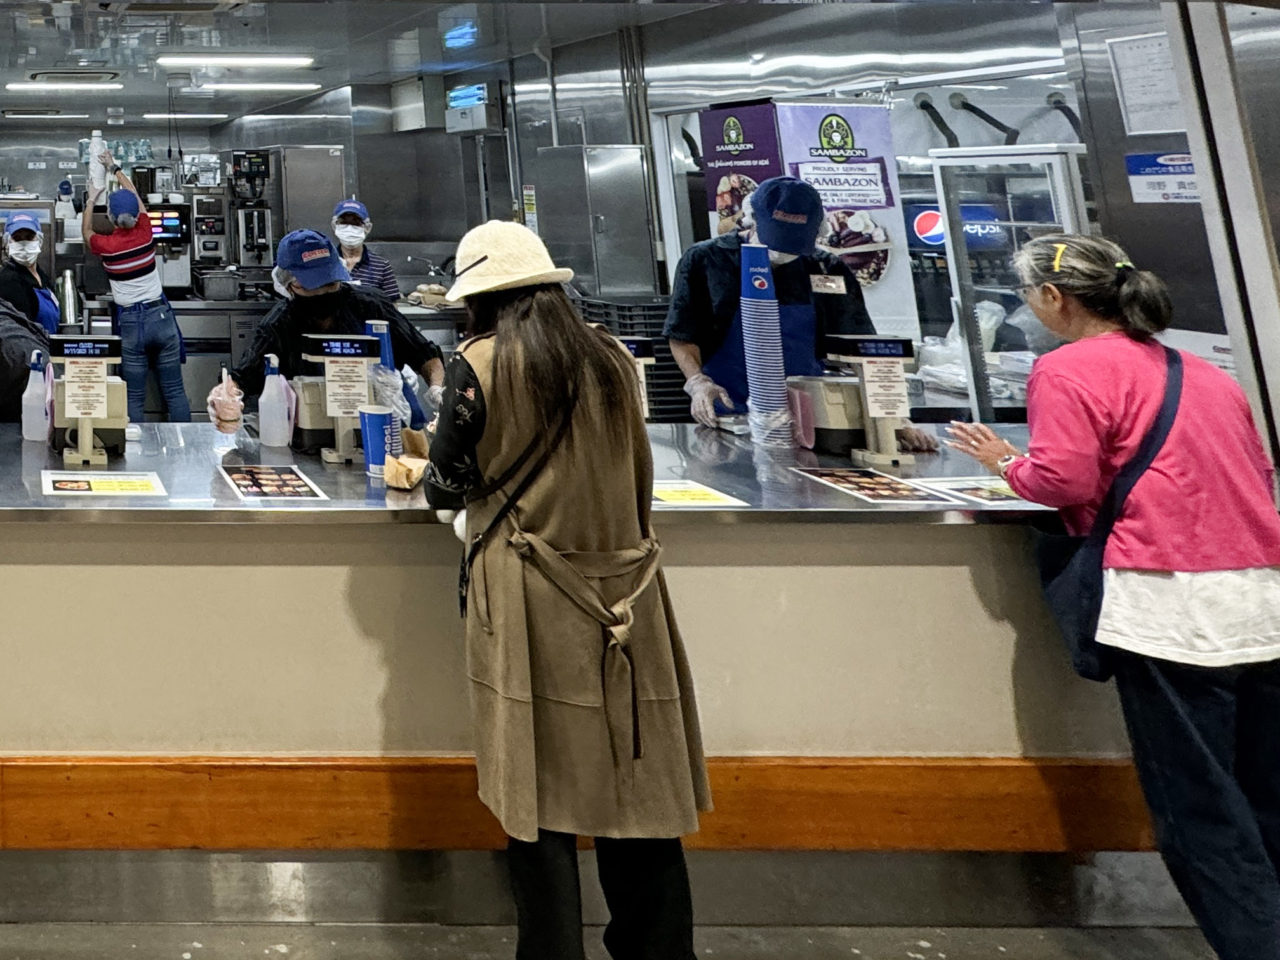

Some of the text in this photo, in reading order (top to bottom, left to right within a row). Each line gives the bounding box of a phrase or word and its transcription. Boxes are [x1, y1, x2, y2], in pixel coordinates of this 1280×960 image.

[716, 143, 754, 151] SAMBAZON
[810, 149, 866, 157] SAMBAZON
[805, 177, 879, 187] SAMBAZON
[963, 218, 1002, 237] epsi
